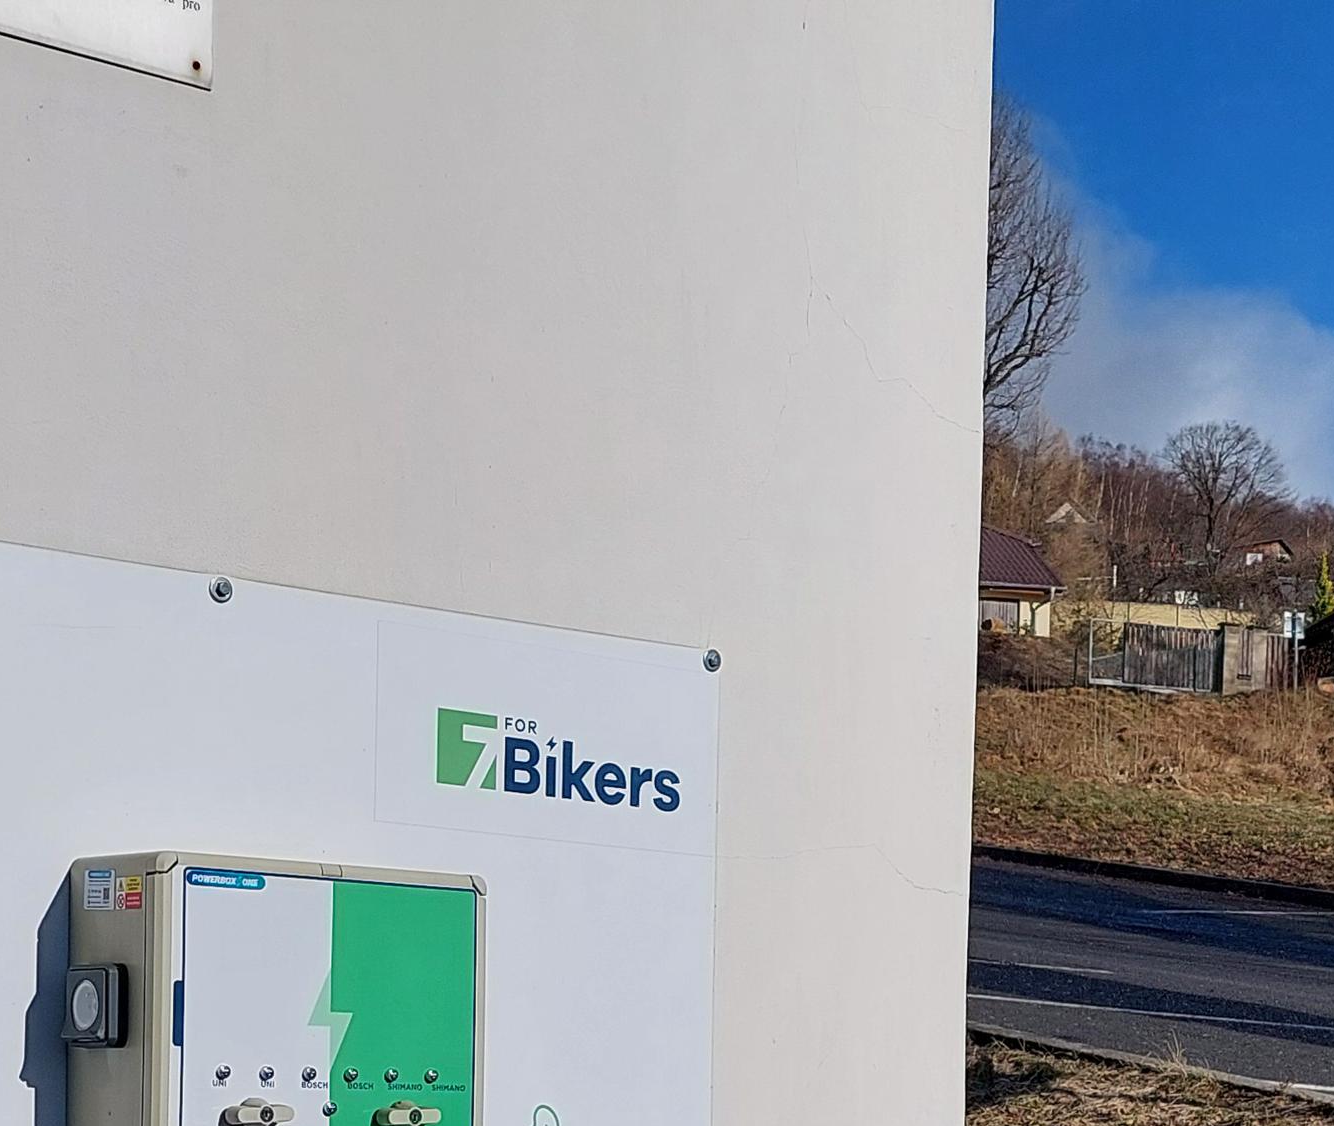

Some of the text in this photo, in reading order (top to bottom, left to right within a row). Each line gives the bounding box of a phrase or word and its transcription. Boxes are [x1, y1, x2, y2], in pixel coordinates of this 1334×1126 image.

[504, 717, 537, 735] FOR
[504, 736, 681, 812] Bikers
[192, 873, 237, 885] POWERBOX
[260, 1080, 275, 1088] UNI
[301, 1081, 328, 1089] BOSCH
[387, 1083, 423, 1091] SHIMANO
[431, 1084, 466, 1092] SHIMANO
